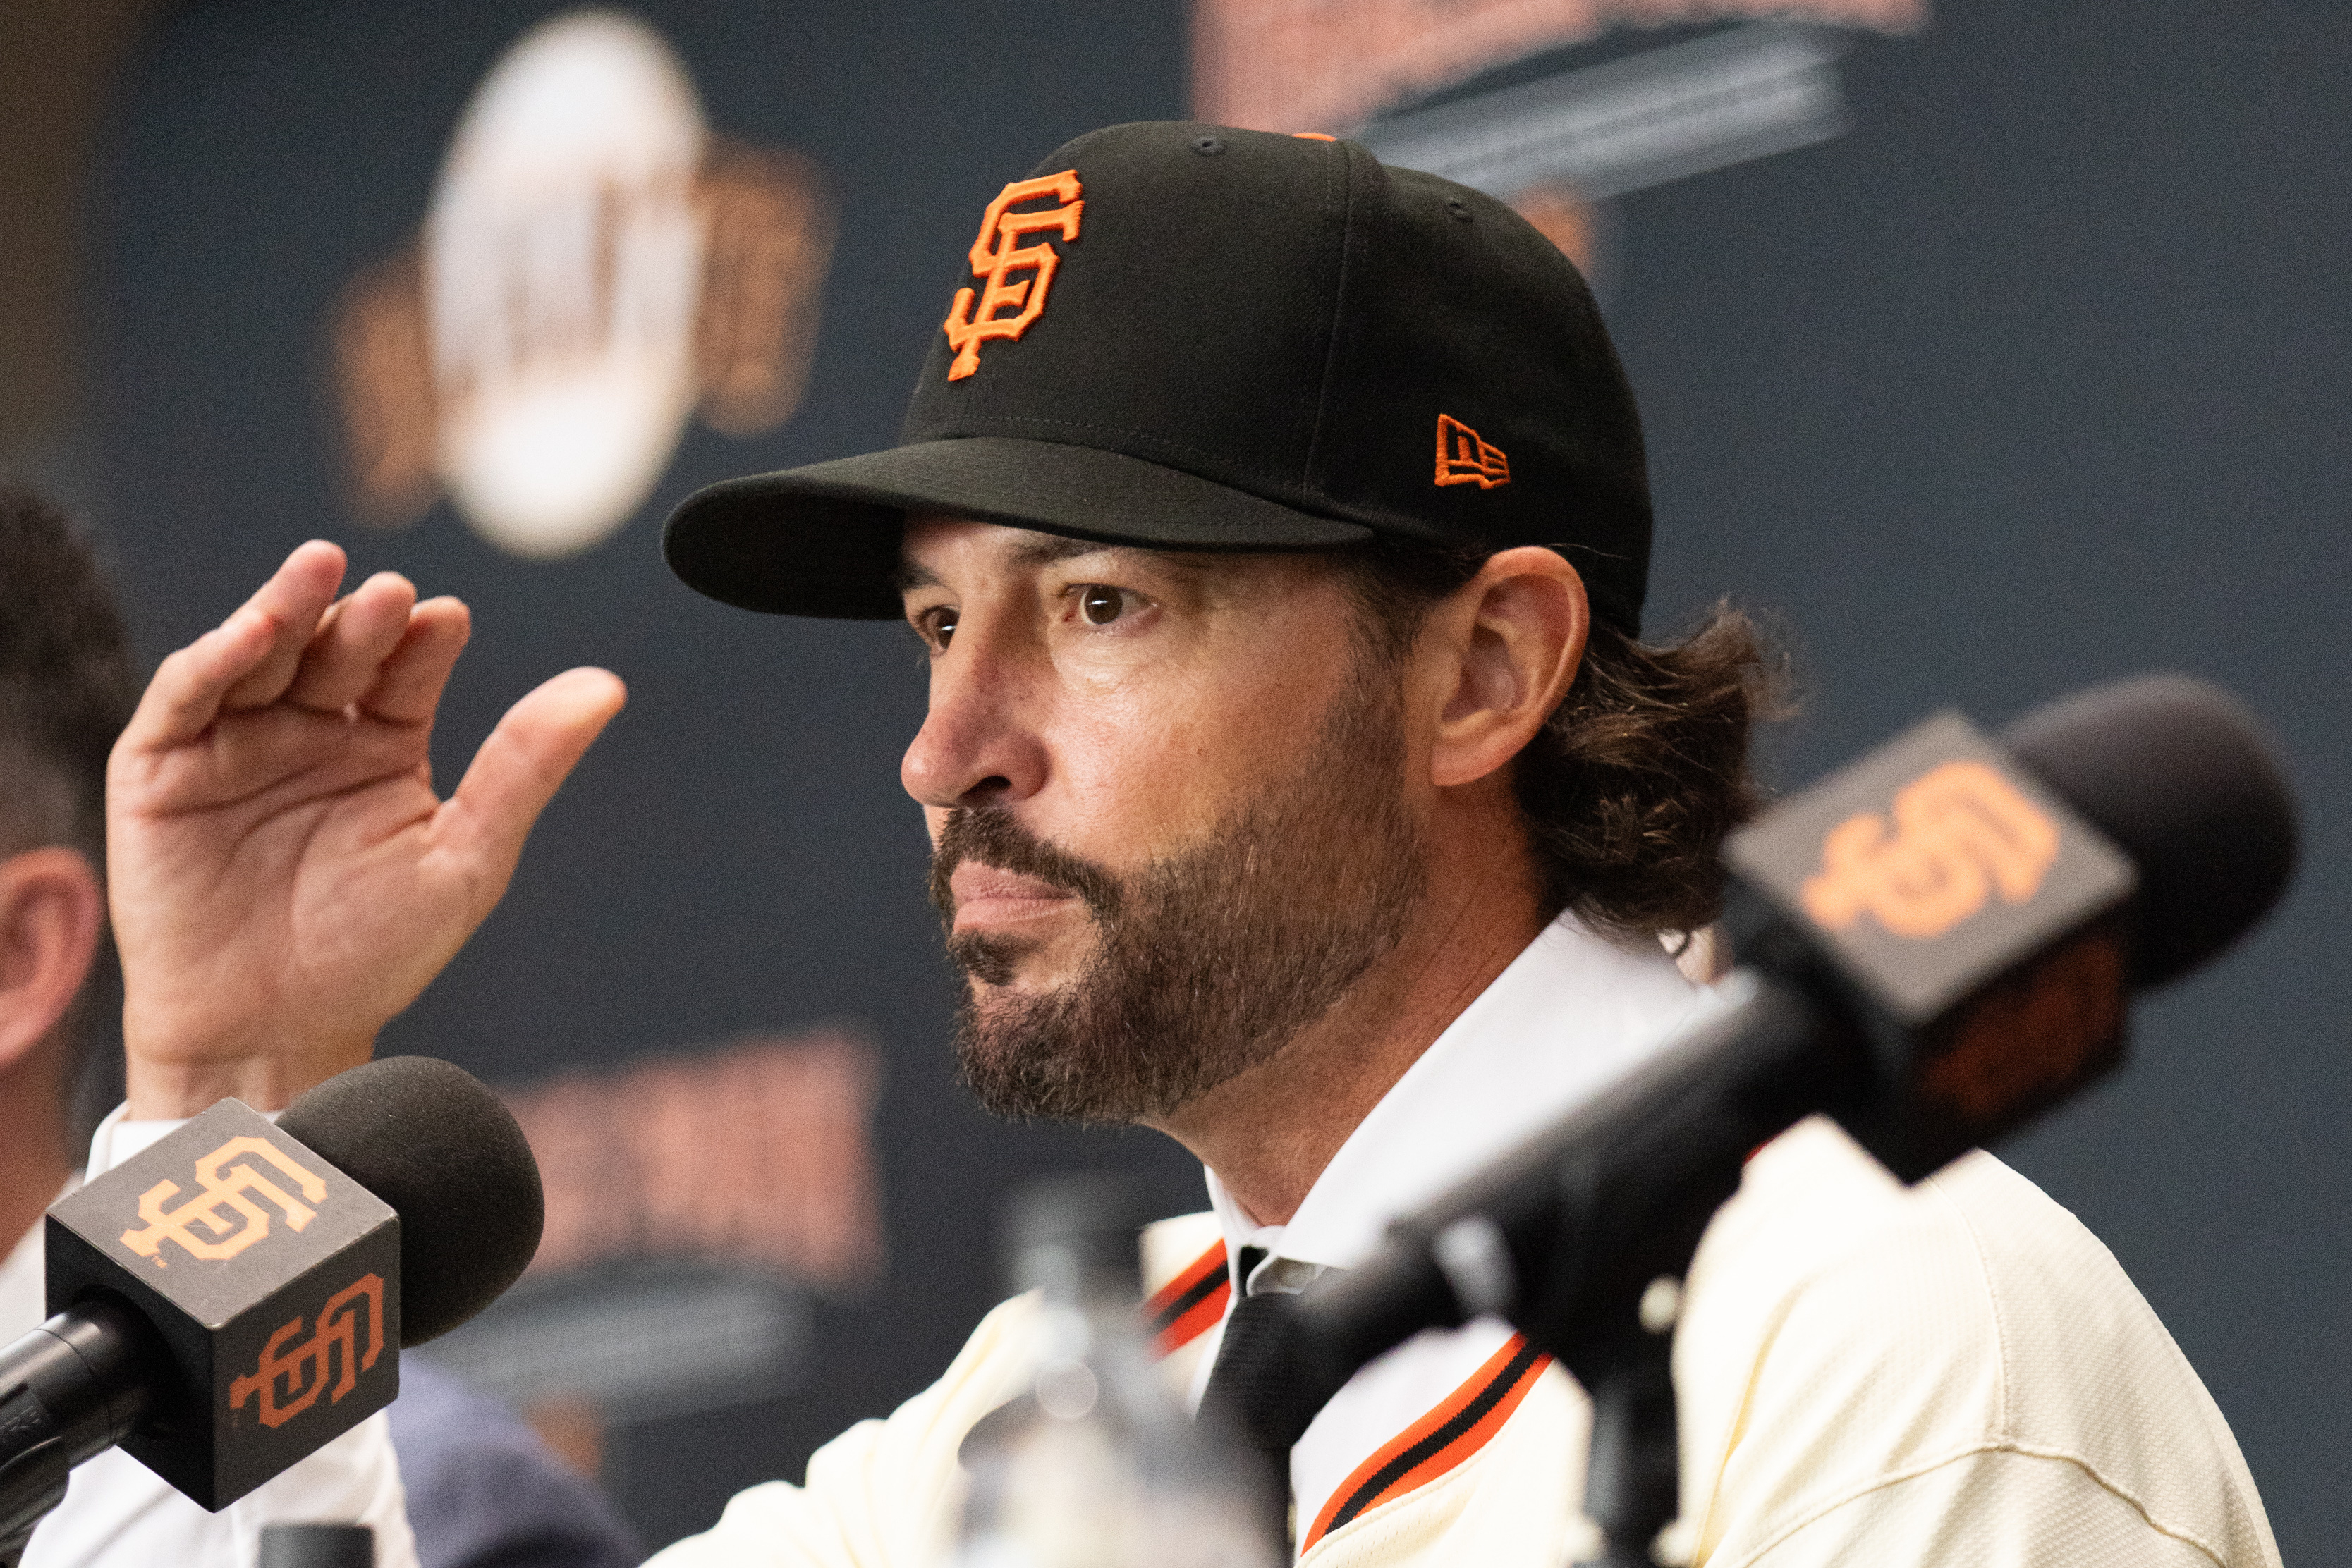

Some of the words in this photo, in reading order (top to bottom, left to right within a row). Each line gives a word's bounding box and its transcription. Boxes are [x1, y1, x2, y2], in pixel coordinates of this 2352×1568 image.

[944, 169, 1085, 381] SF
[120, 1136, 327, 1261] SF
[229, 1273, 384, 1428] SF
